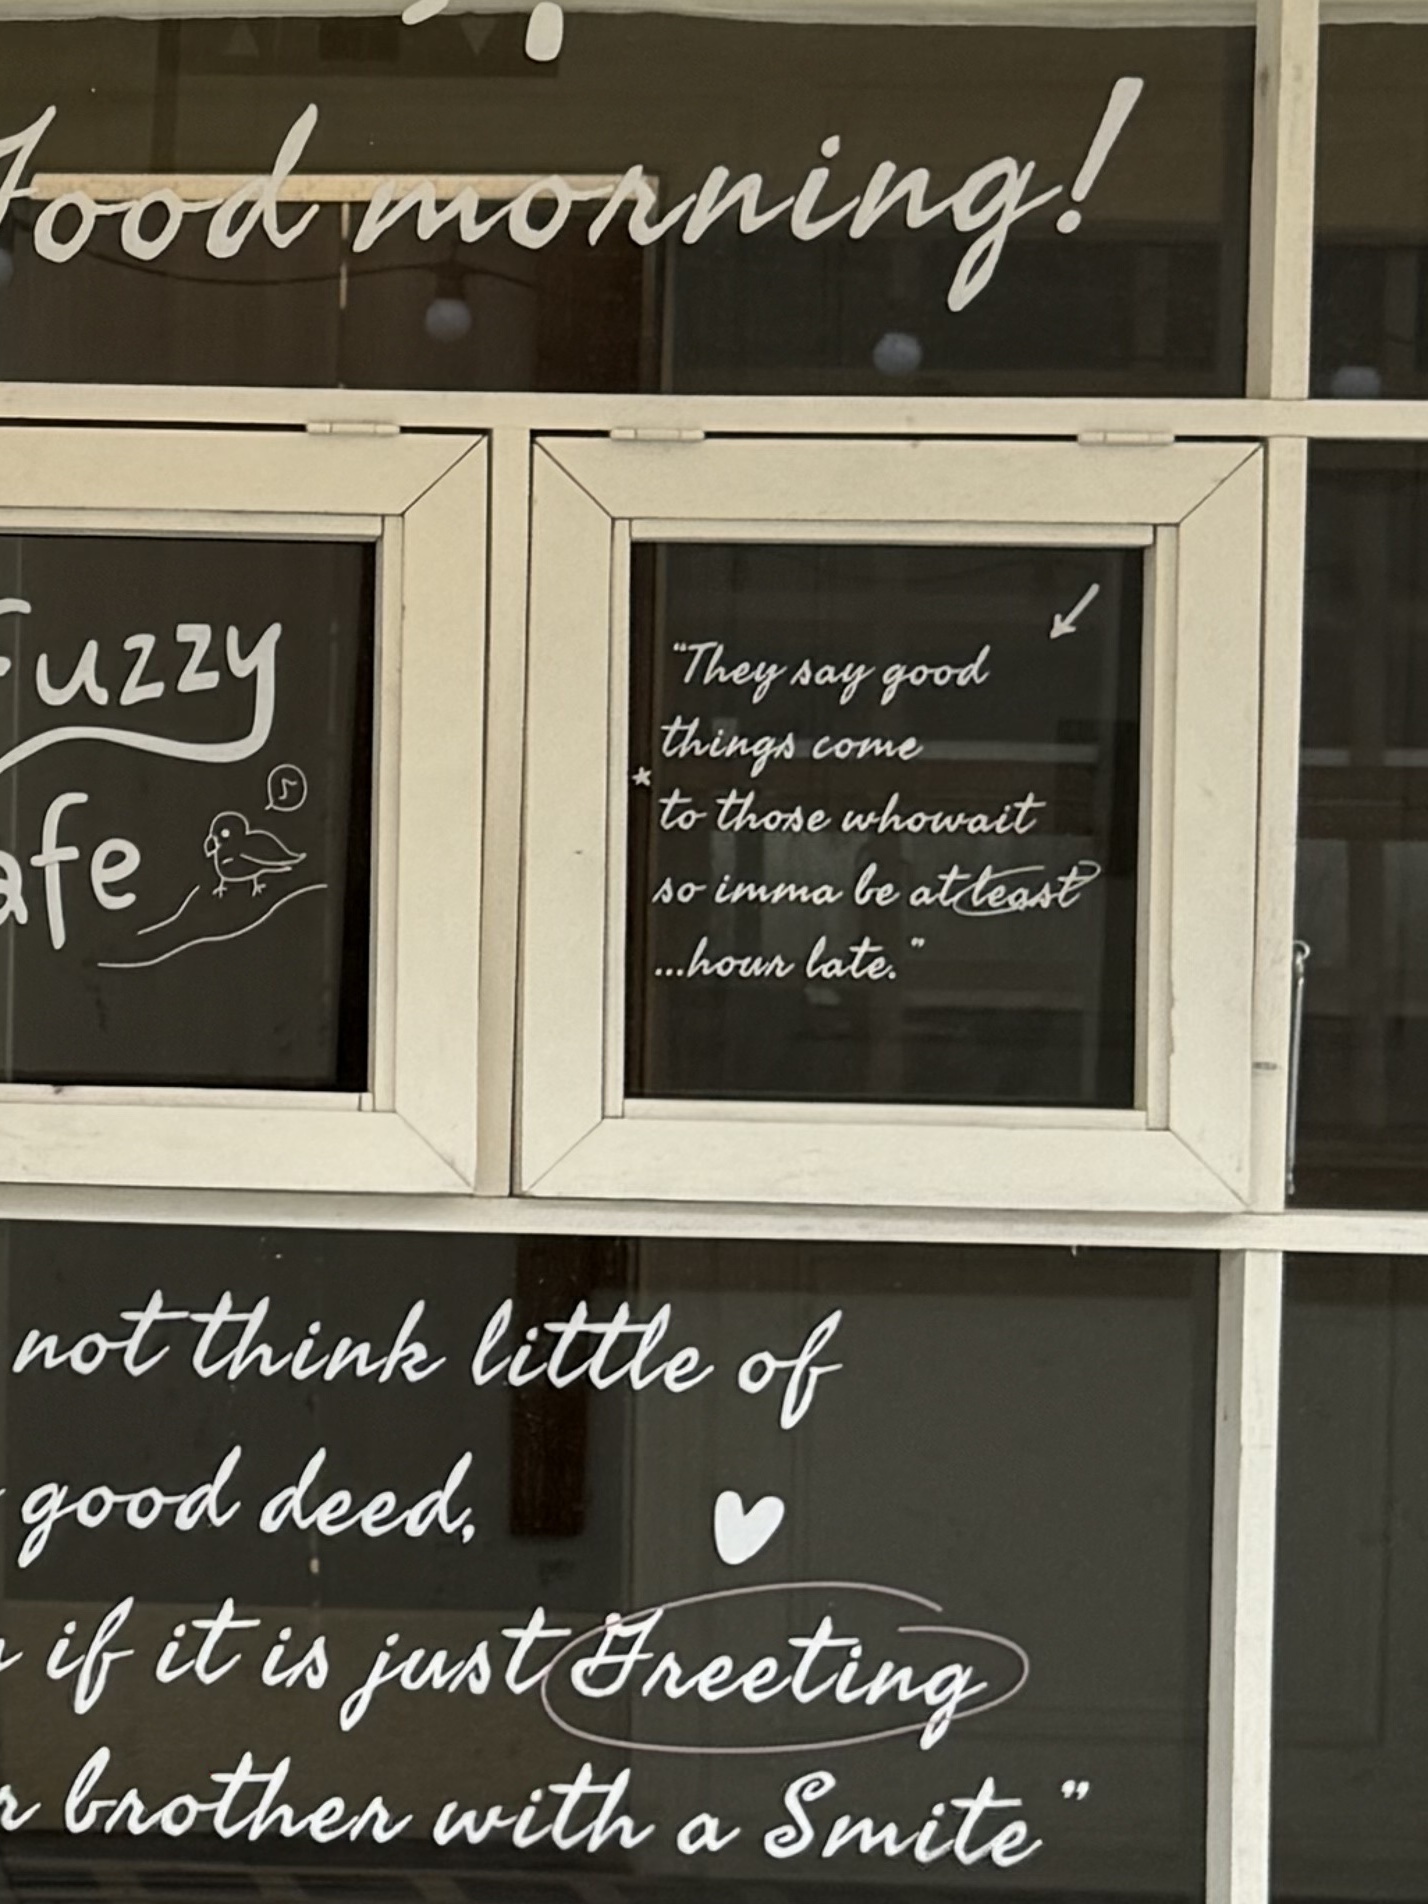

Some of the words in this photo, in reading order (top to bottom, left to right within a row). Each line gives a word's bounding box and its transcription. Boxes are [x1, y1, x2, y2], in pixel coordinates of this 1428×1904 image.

[352, 78, 1143, 311] morning!
[791, 660, 874, 704] say
[881, 646, 990, 705] good
[661, 716, 794, 777] things
[813, 737, 923, 760] come
[660, 789, 706, 829] to
[717, 789, 831, 832] those
[652, 878, 706, 905] so
[715, 870, 843, 906] imma
[855, 863, 899, 906] be
[14, 1290, 178, 1377] not
[190, 1292, 446, 1382] think
[473, 1299, 714, 1392] little
[739, 1311, 842, 1429] of
[18, 1446, 241, 1567] good
[260, 1448, 474, 1542] deed,
[47, 1597, 134, 1714] if
[156, 1598, 252, 1686] it
[262, 1637, 328, 1688] is
[341, 1606, 569, 1733] just
[571, 1607, 986, 1747] Greeting
[66, 1747, 412, 1842] brother
[434, 1763, 654, 1851] with
[678, 1813, 740, 1854] a
